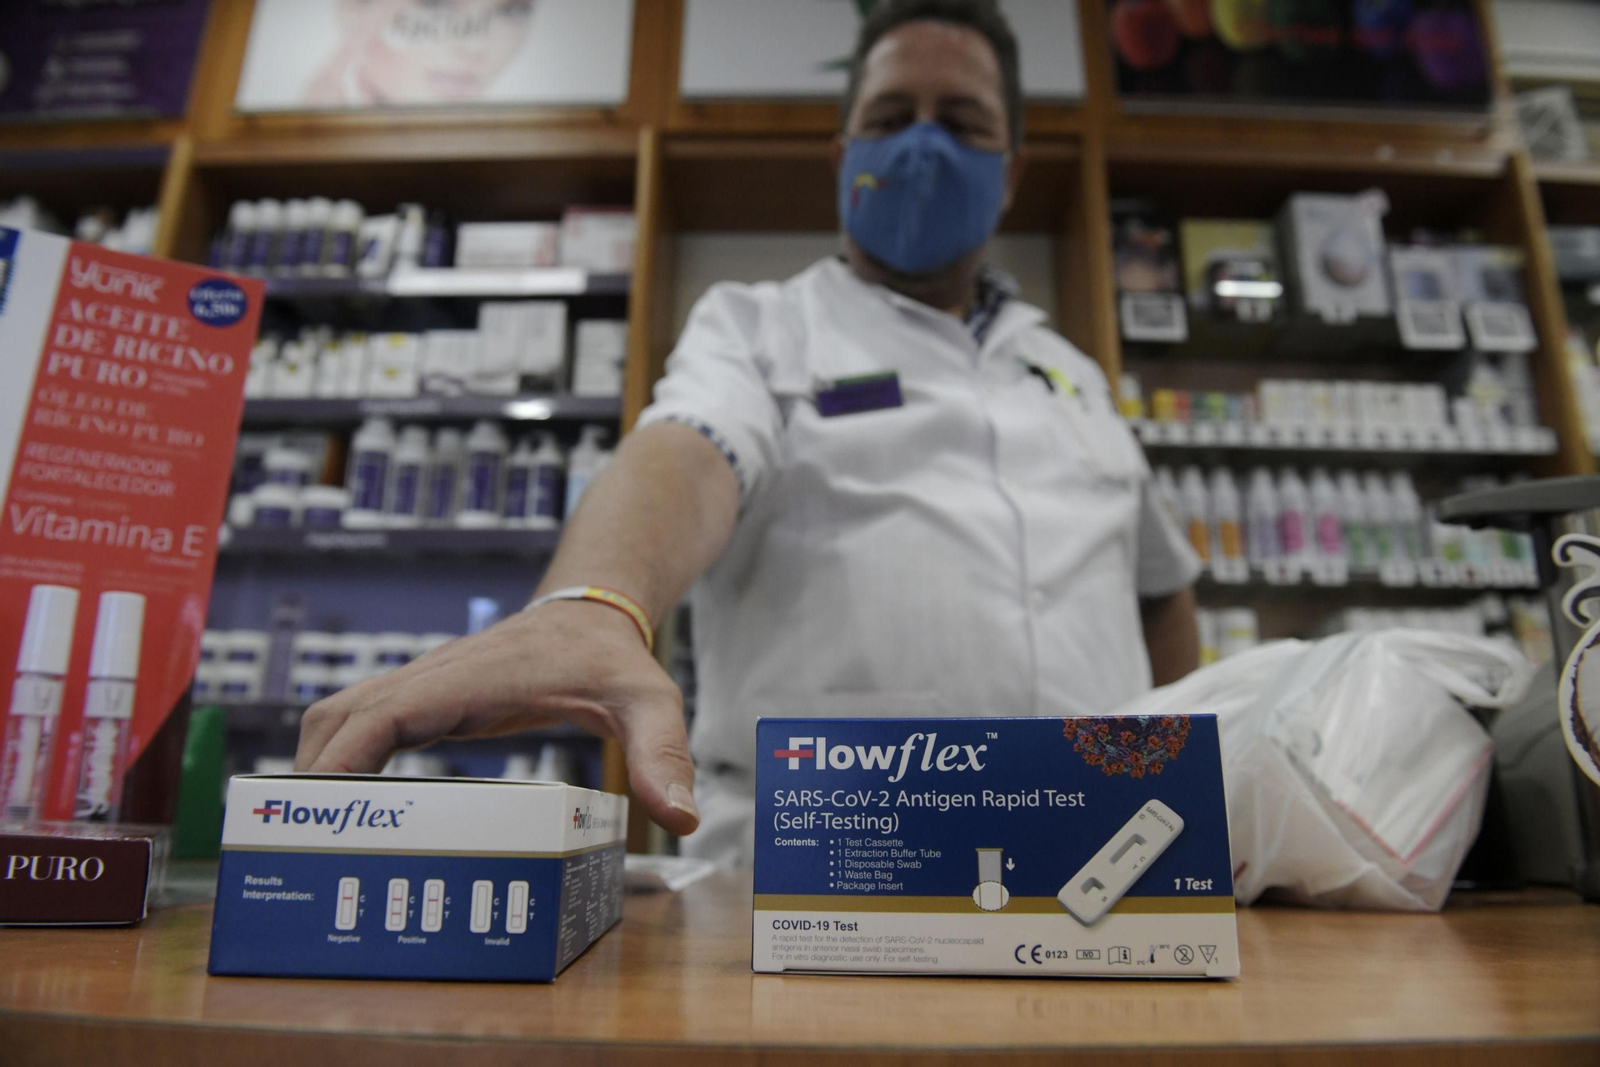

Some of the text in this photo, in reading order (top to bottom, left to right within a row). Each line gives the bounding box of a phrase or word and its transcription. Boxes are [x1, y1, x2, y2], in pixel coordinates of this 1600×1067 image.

[58, 298, 193, 342] ACEITE
[53, 323, 235, 376] DE RICINO
[47, 351, 148, 389] PURO
[9, 502, 207, 558] Vitamina E
[774, 732, 988, 783] Flowflex
[773, 789, 1086, 812] SARS-CoV-2 Antigen Rapid Test
[253, 799, 405, 835] Flowflex
[773, 812, 900, 834] (Self-Testing)
[774, 837, 820, 847] Contents:
[845, 838, 863, 847] Test
[864, 838, 904, 847] Cassette
[845, 849, 889, 858] Extraction
[891, 849, 917, 858] Buffer
[920, 850, 942, 858] Tube
[4, 855, 105, 881] PURO
[845, 860, 895, 870] Disposable
[897, 860, 922, 869] Swab
[244, 875, 283, 886] Results
[845, 871, 872, 879] Waste
[874, 871, 893, 881] Bag
[836, 881, 904, 892] Package Insert
[1174, 877, 1213, 891] 1 Test
[242, 889, 315, 902] Interpretation:
[772, 919, 858, 932] COVID-19 Test
[327, 934, 361, 944] Negative
[397, 935, 427, 945] Positive
[484, 937, 511, 946] Invalid
[779, 934, 798, 944] rapid
[799, 935, 812, 943] test
[814, 935, 824, 943] for
[826, 935, 837, 943] the
[839, 935, 874, 944] detection
[884, 936, 933, 945] SARS-CoV-2
[771, 953, 784, 961] For
[810, 953, 848, 963] diagnostic
[884, 955, 895, 963] For
[1045, 950, 1068, 959] 0123
